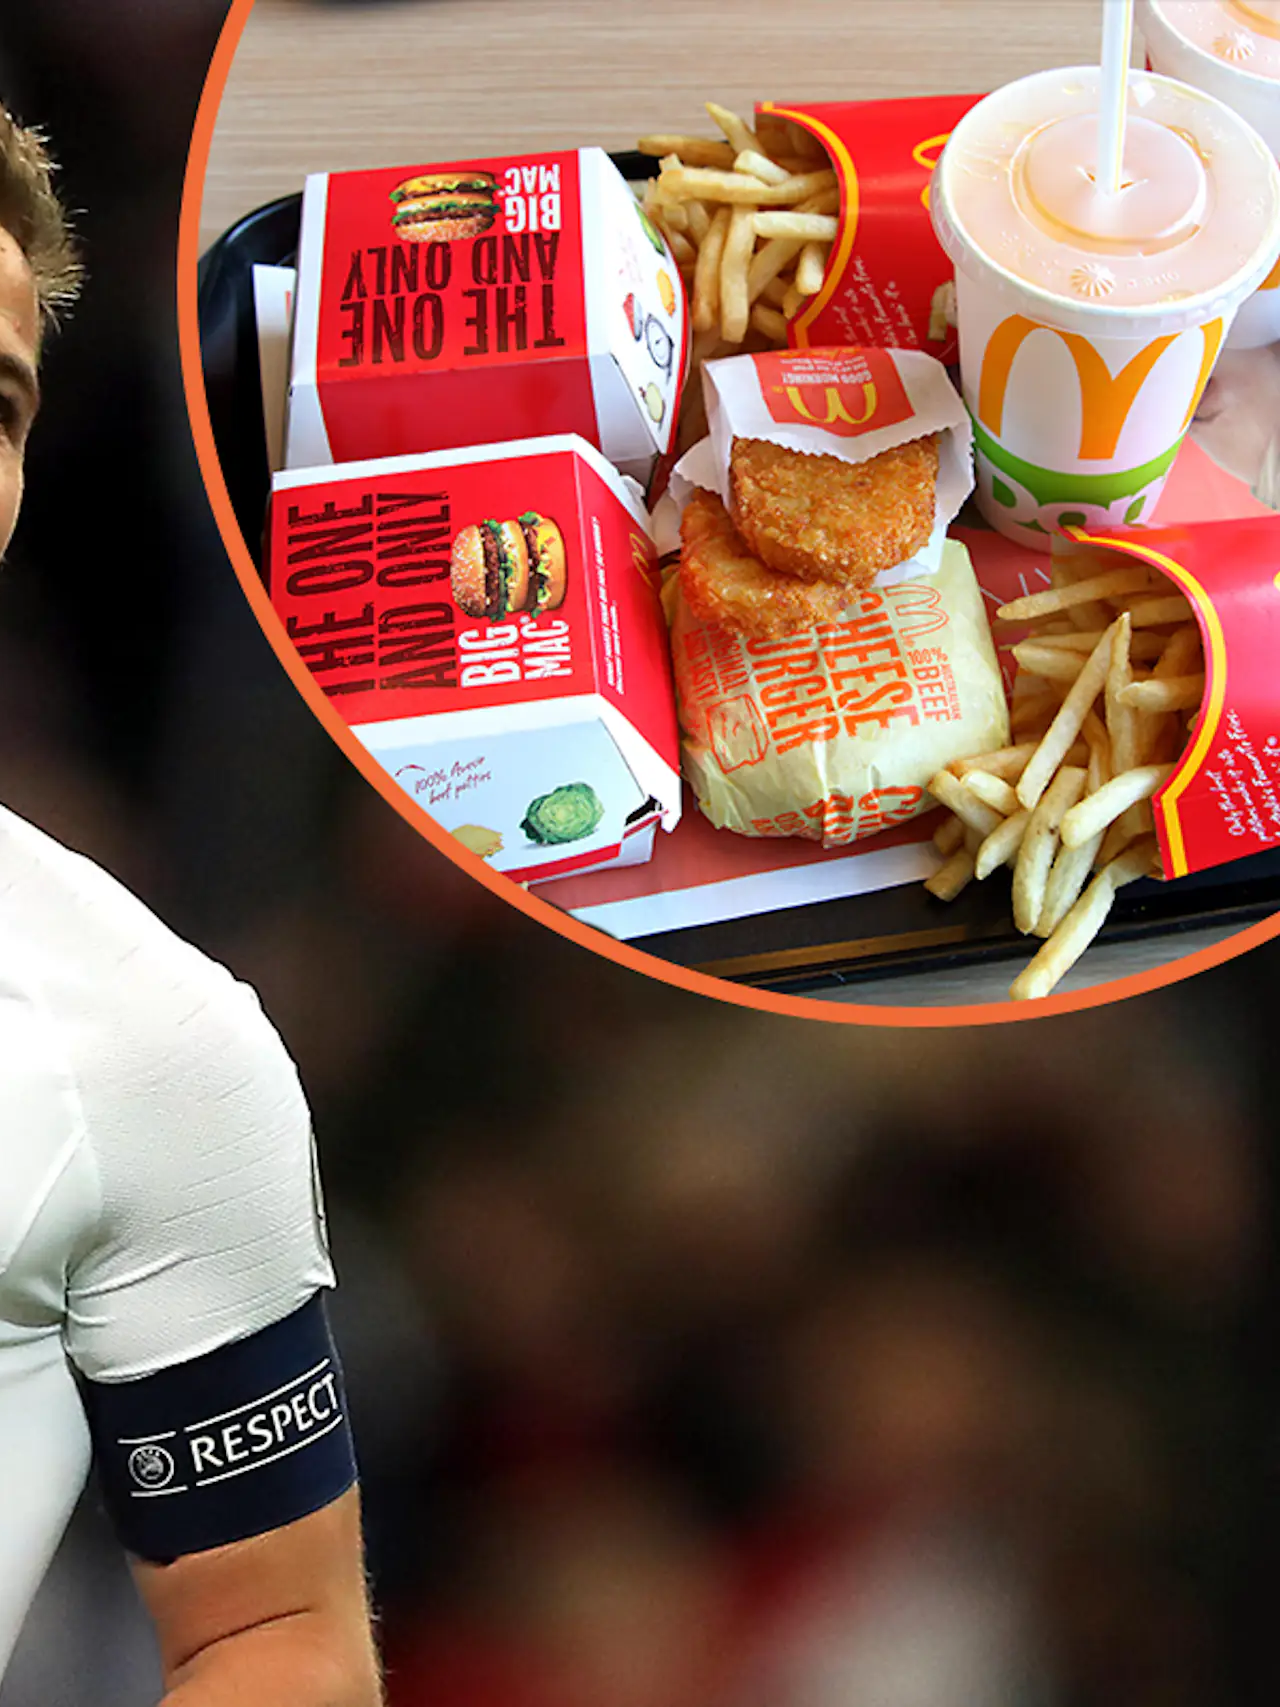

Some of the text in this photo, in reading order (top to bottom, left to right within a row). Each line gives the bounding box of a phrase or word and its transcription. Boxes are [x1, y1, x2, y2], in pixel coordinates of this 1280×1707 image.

[504, 163, 561, 193] MAC
[505, 193, 561, 233] BIG
[341, 232, 561, 299] AND ONLY
[338, 283, 566, 367] THE ONE
[286, 492, 374, 596] ONE
[376, 490, 458, 690] AND ONLY
[457, 623, 522, 689] BIG
[522, 618, 573, 681] MAC
[745, 627, 841, 756] URGER
[912, 662, 953, 724] BEEF
[189, 1372, 340, 1474] RESPECT
